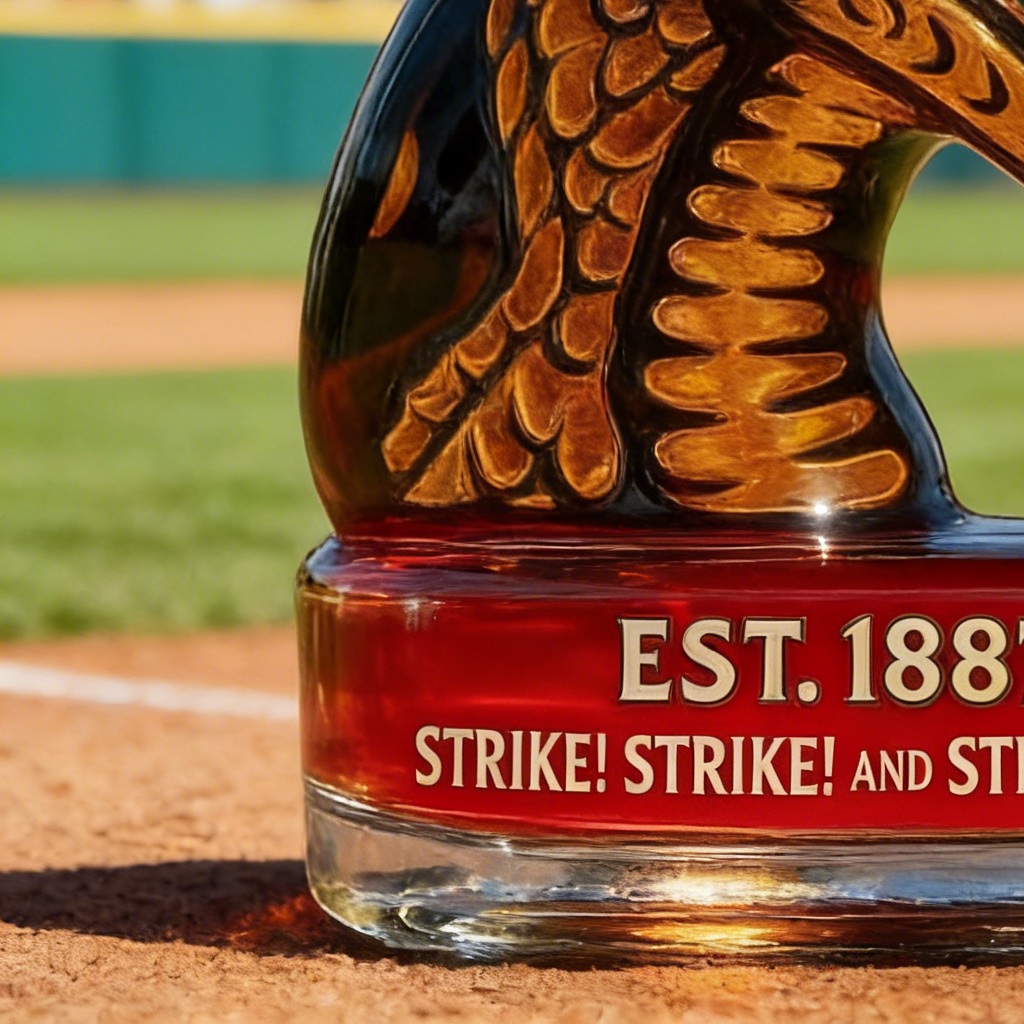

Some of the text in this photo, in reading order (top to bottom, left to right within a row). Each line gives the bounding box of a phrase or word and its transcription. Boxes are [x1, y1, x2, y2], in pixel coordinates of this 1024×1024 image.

[618, 617, 820, 704] EST.
[414, 725, 608, 794] STRIKE!
[623, 733, 836, 797] STRIKE!
[849, 748, 935, 793] AND
